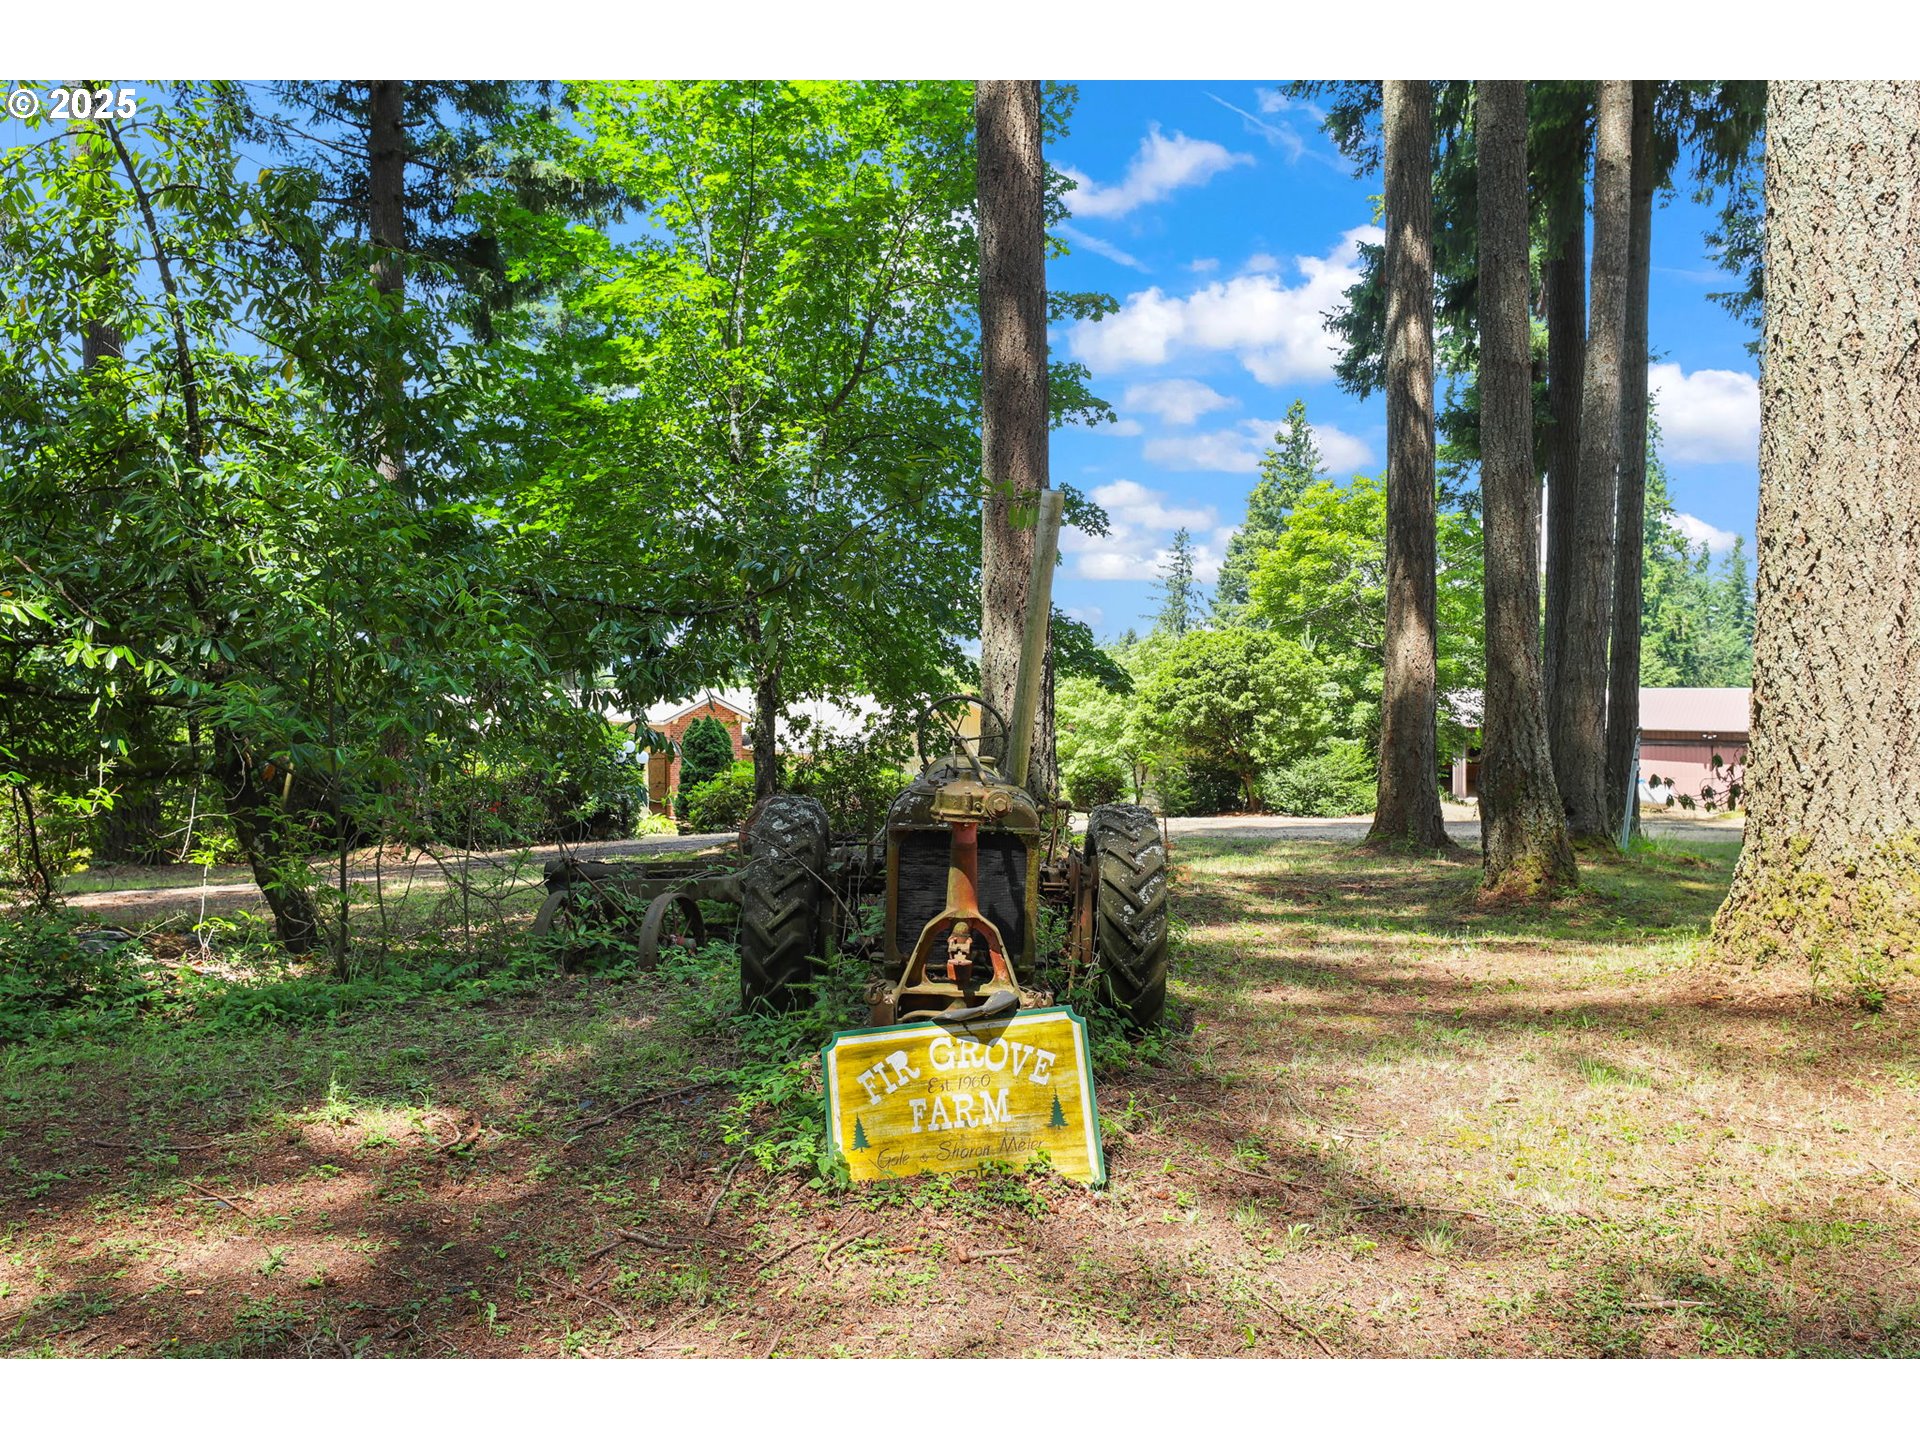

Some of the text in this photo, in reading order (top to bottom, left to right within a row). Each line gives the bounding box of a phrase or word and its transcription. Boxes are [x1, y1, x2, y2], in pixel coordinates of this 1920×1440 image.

[856, 1036, 1056, 1105] FIR GROVE
[958, 1073, 991, 1090] 1960
[909, 1088, 1013, 1133] FARM
[877, 1147, 910, 1169] Gale
[936, 1140, 991, 1161] Sharon
[999, 1136, 1045, 1153] Meier
